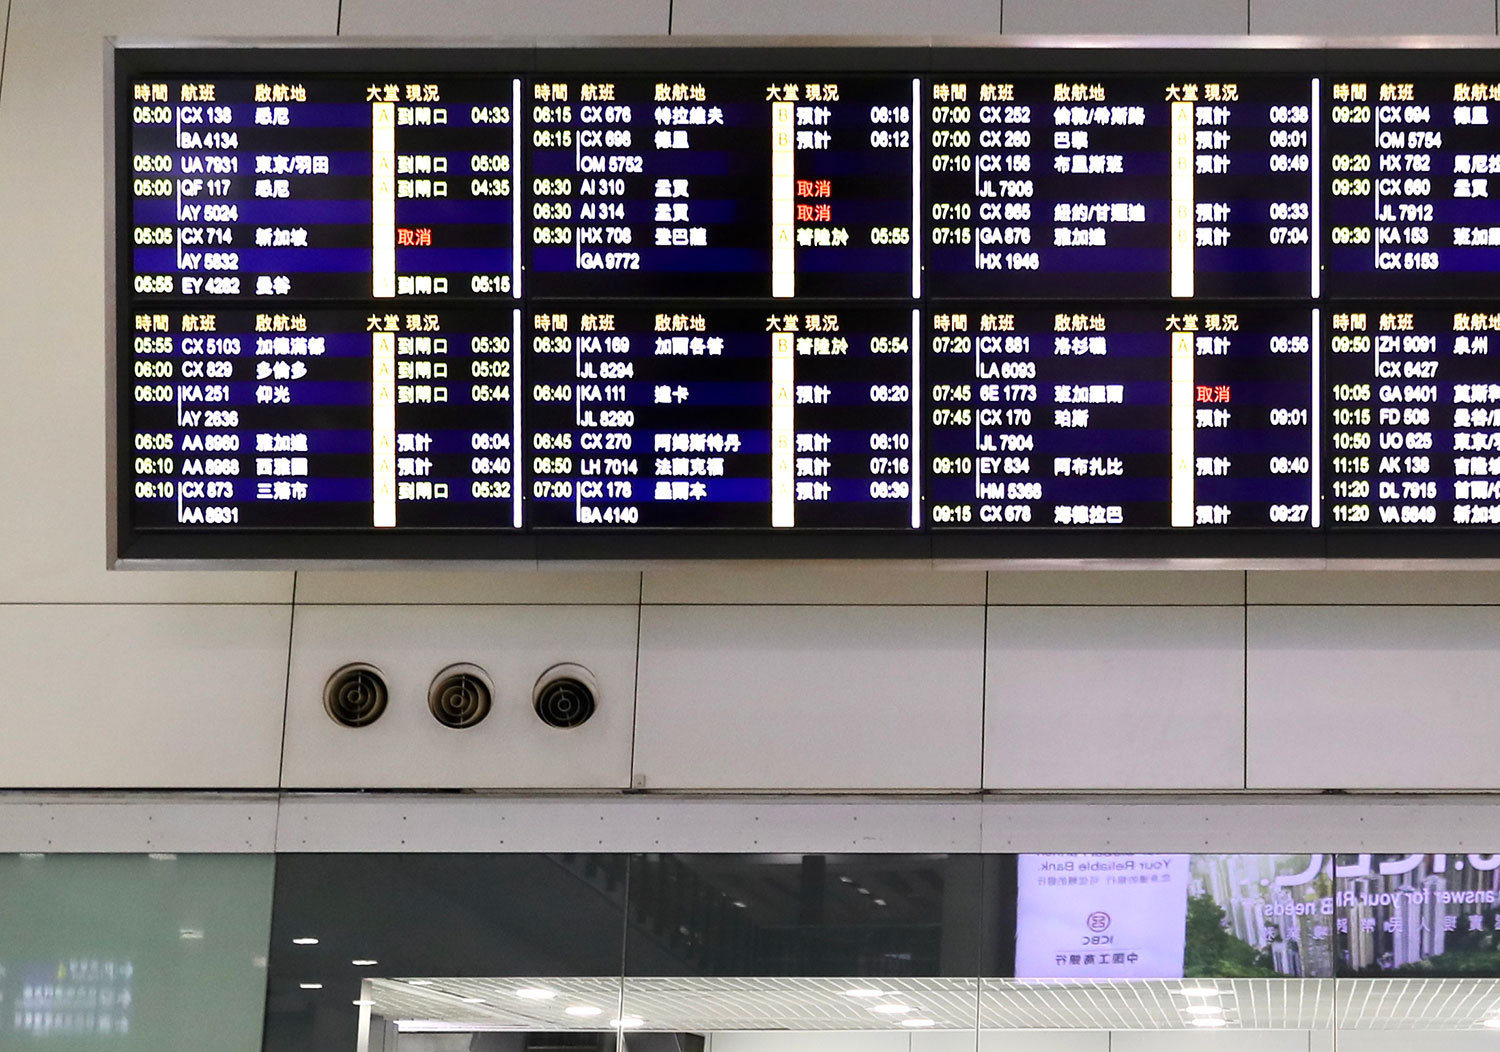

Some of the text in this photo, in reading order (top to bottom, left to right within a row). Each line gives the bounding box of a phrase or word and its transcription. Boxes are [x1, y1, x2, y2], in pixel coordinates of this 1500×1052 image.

[135, 84, 167, 102] 時間
[181, 84, 215, 101] 航班
[367, 85, 399, 102] 大堂
[934, 84, 966, 101] 時間
[980, 84, 1014, 101] 航班
[1166, 84, 1198, 101] 大堂
[133, 107, 171, 123] 05:00
[181, 107, 203, 123] CX
[472, 107, 509, 123] 04:33
[181, 132, 238, 149] BA 4134
[933, 131, 970, 147] 07:00
[980, 131, 1001, 147] CX
[134, 155, 172, 171] 05:00
[181, 156, 203, 173] UA
[609, 156, 642, 172] 5752
[134, 179, 172, 196] 05:00
[207, 179, 230, 195] 117
[472, 179, 509, 195] 04:35
[580, 179, 595, 195] AI
[599, 179, 624, 195] 310
[799, 180, 830, 197] 取消
[180, 205, 201, 221] AY
[134, 228, 172, 244] 05:05
[180, 228, 203, 244] CX
[207, 228, 232, 244] 714
[400, 228, 431, 246] 取消
[1333, 314, 1366, 331] 時間
[1380, 313, 1413, 330] 航班
[180, 385, 203, 401] KA
[205, 385, 229, 401] 251
[256, 385, 290, 403] 仰光
[472, 385, 510, 401] 05:44
[579, 385, 602, 401] KA
[605, 385, 625, 401] 111
[933, 385, 971, 401] 07:45
[1004, 385, 1036, 401] 1773
[1199, 386, 1230, 402] 取消
[1333, 433, 1370, 449] 10:50
